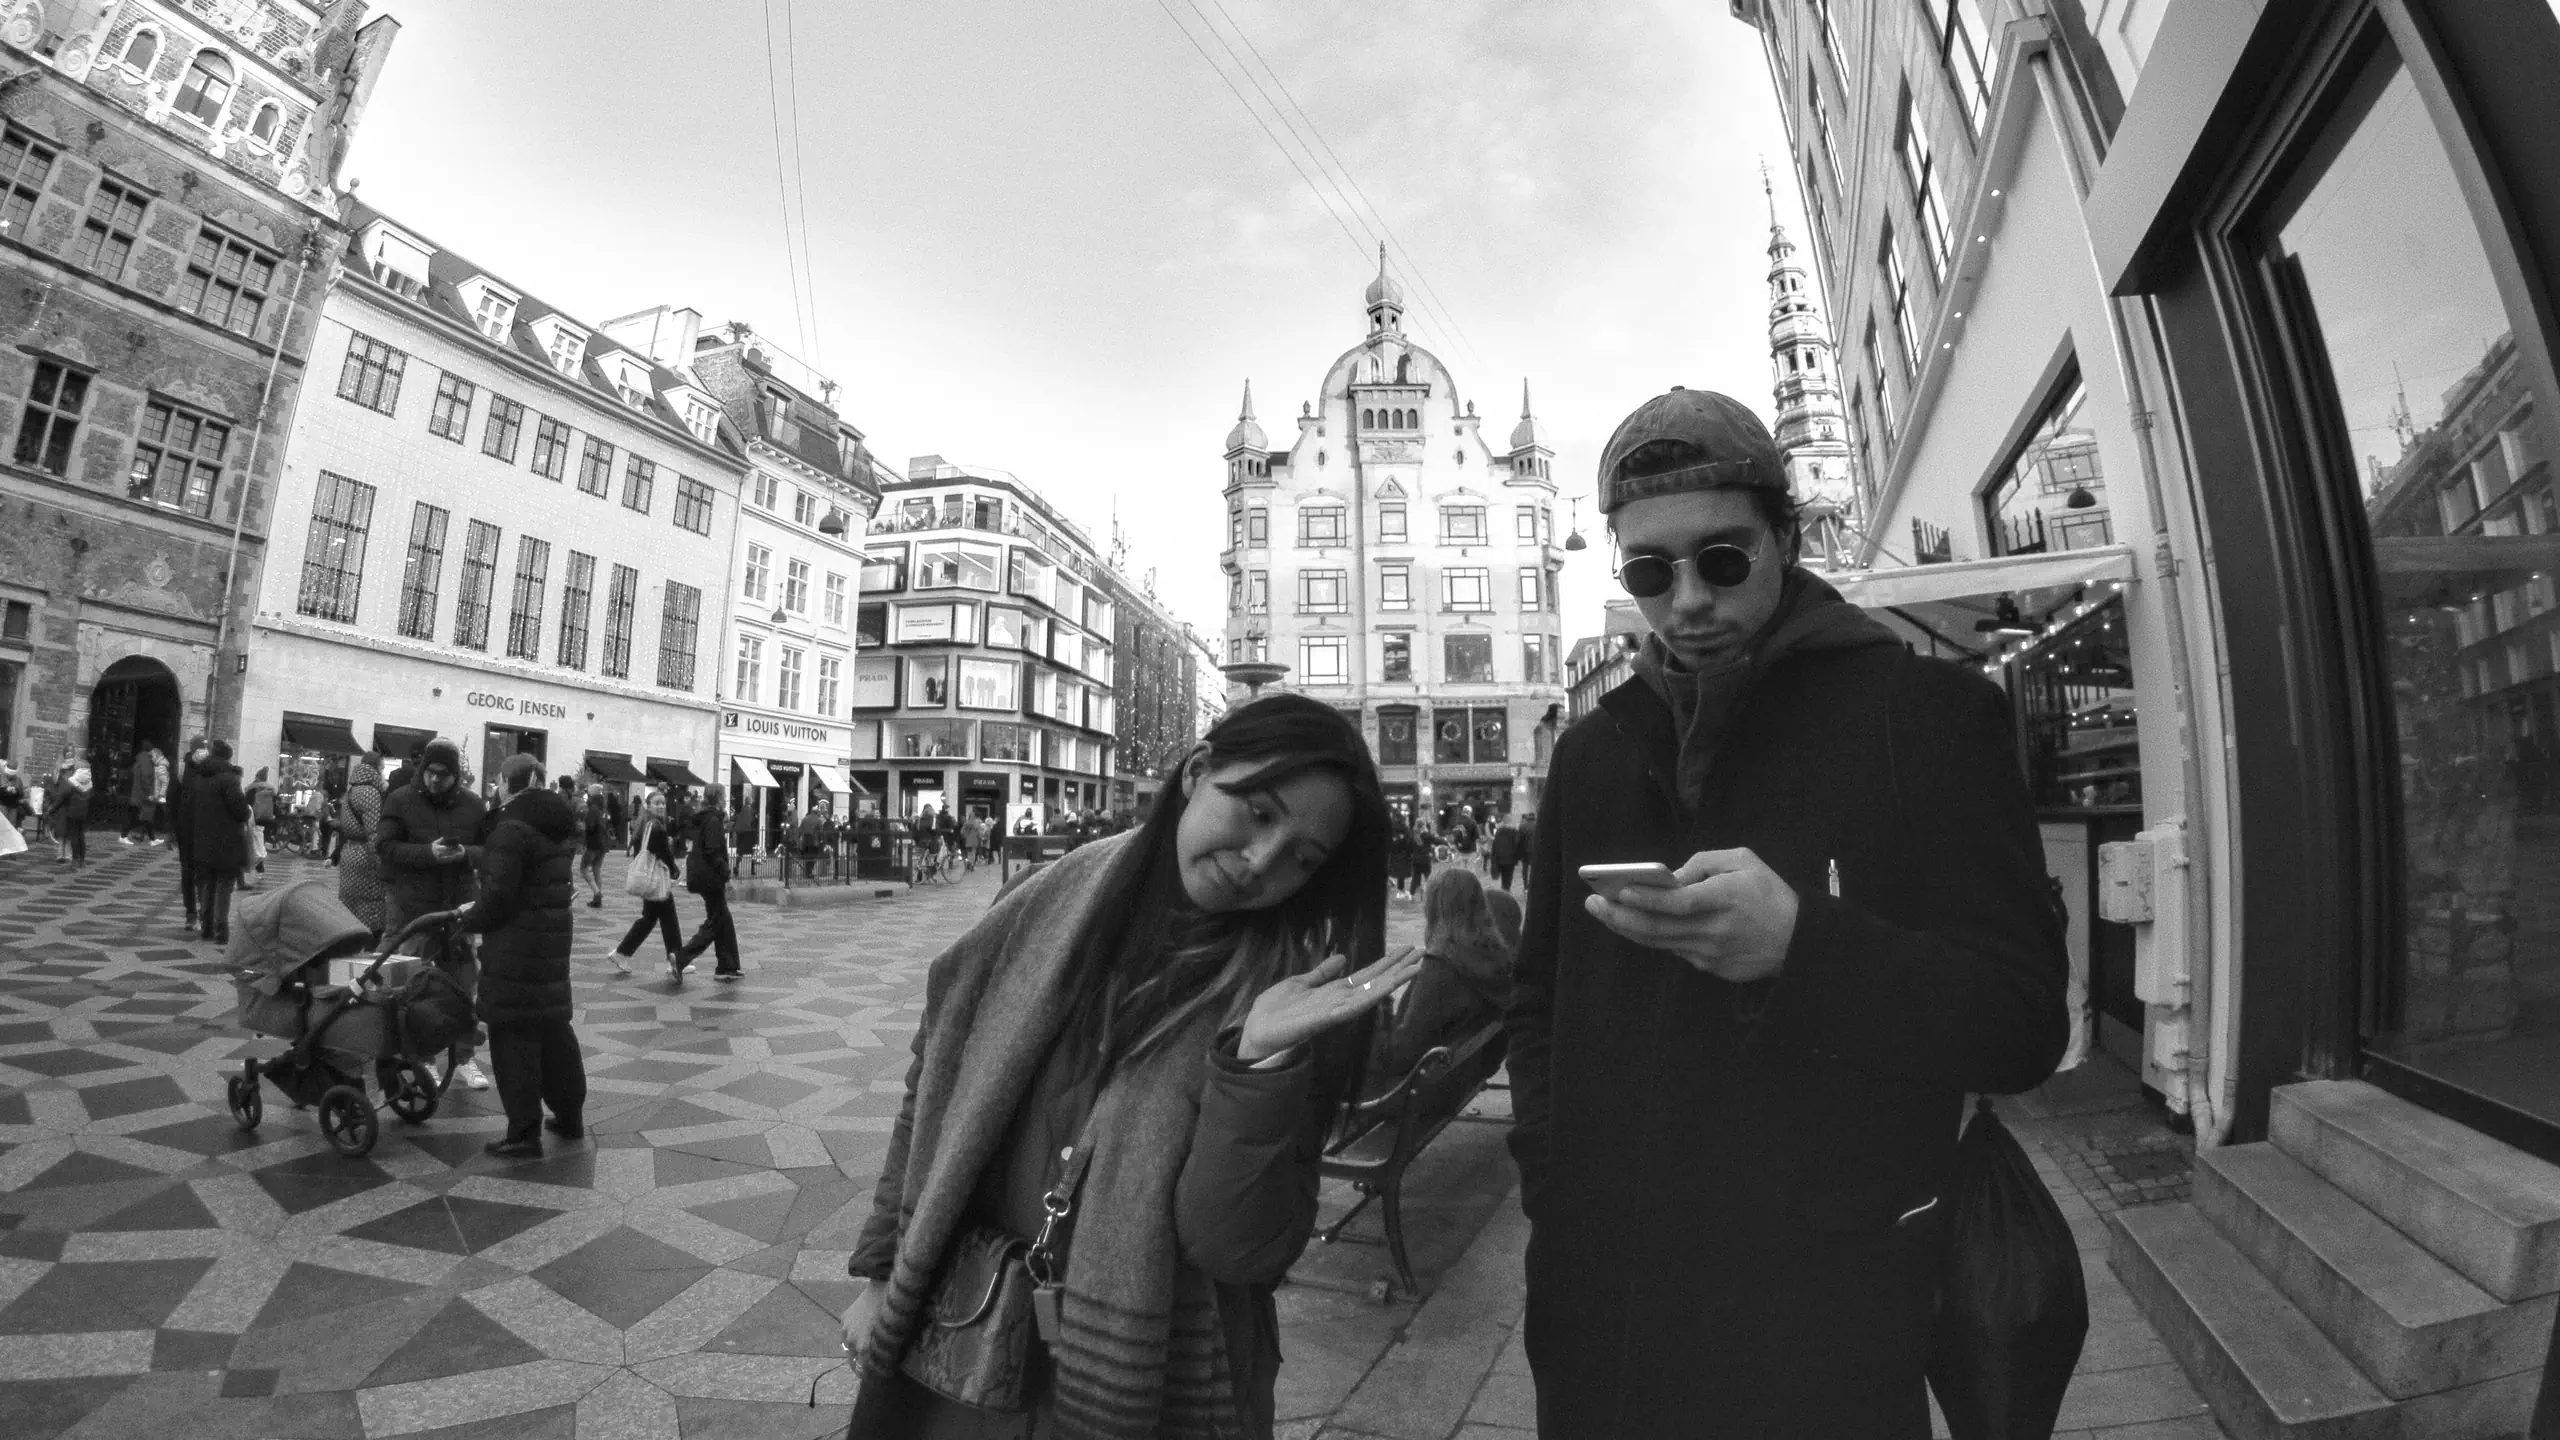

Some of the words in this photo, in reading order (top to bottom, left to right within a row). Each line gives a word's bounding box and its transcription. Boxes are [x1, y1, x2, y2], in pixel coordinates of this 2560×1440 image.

[467, 692, 514, 711] GEORG
[519, 699, 566, 719] JENSEN
[746, 718, 779, 736] LOUIS
[783, 723, 827, 742] VUITTON
[783, 765, 800, 773] VUITTON
